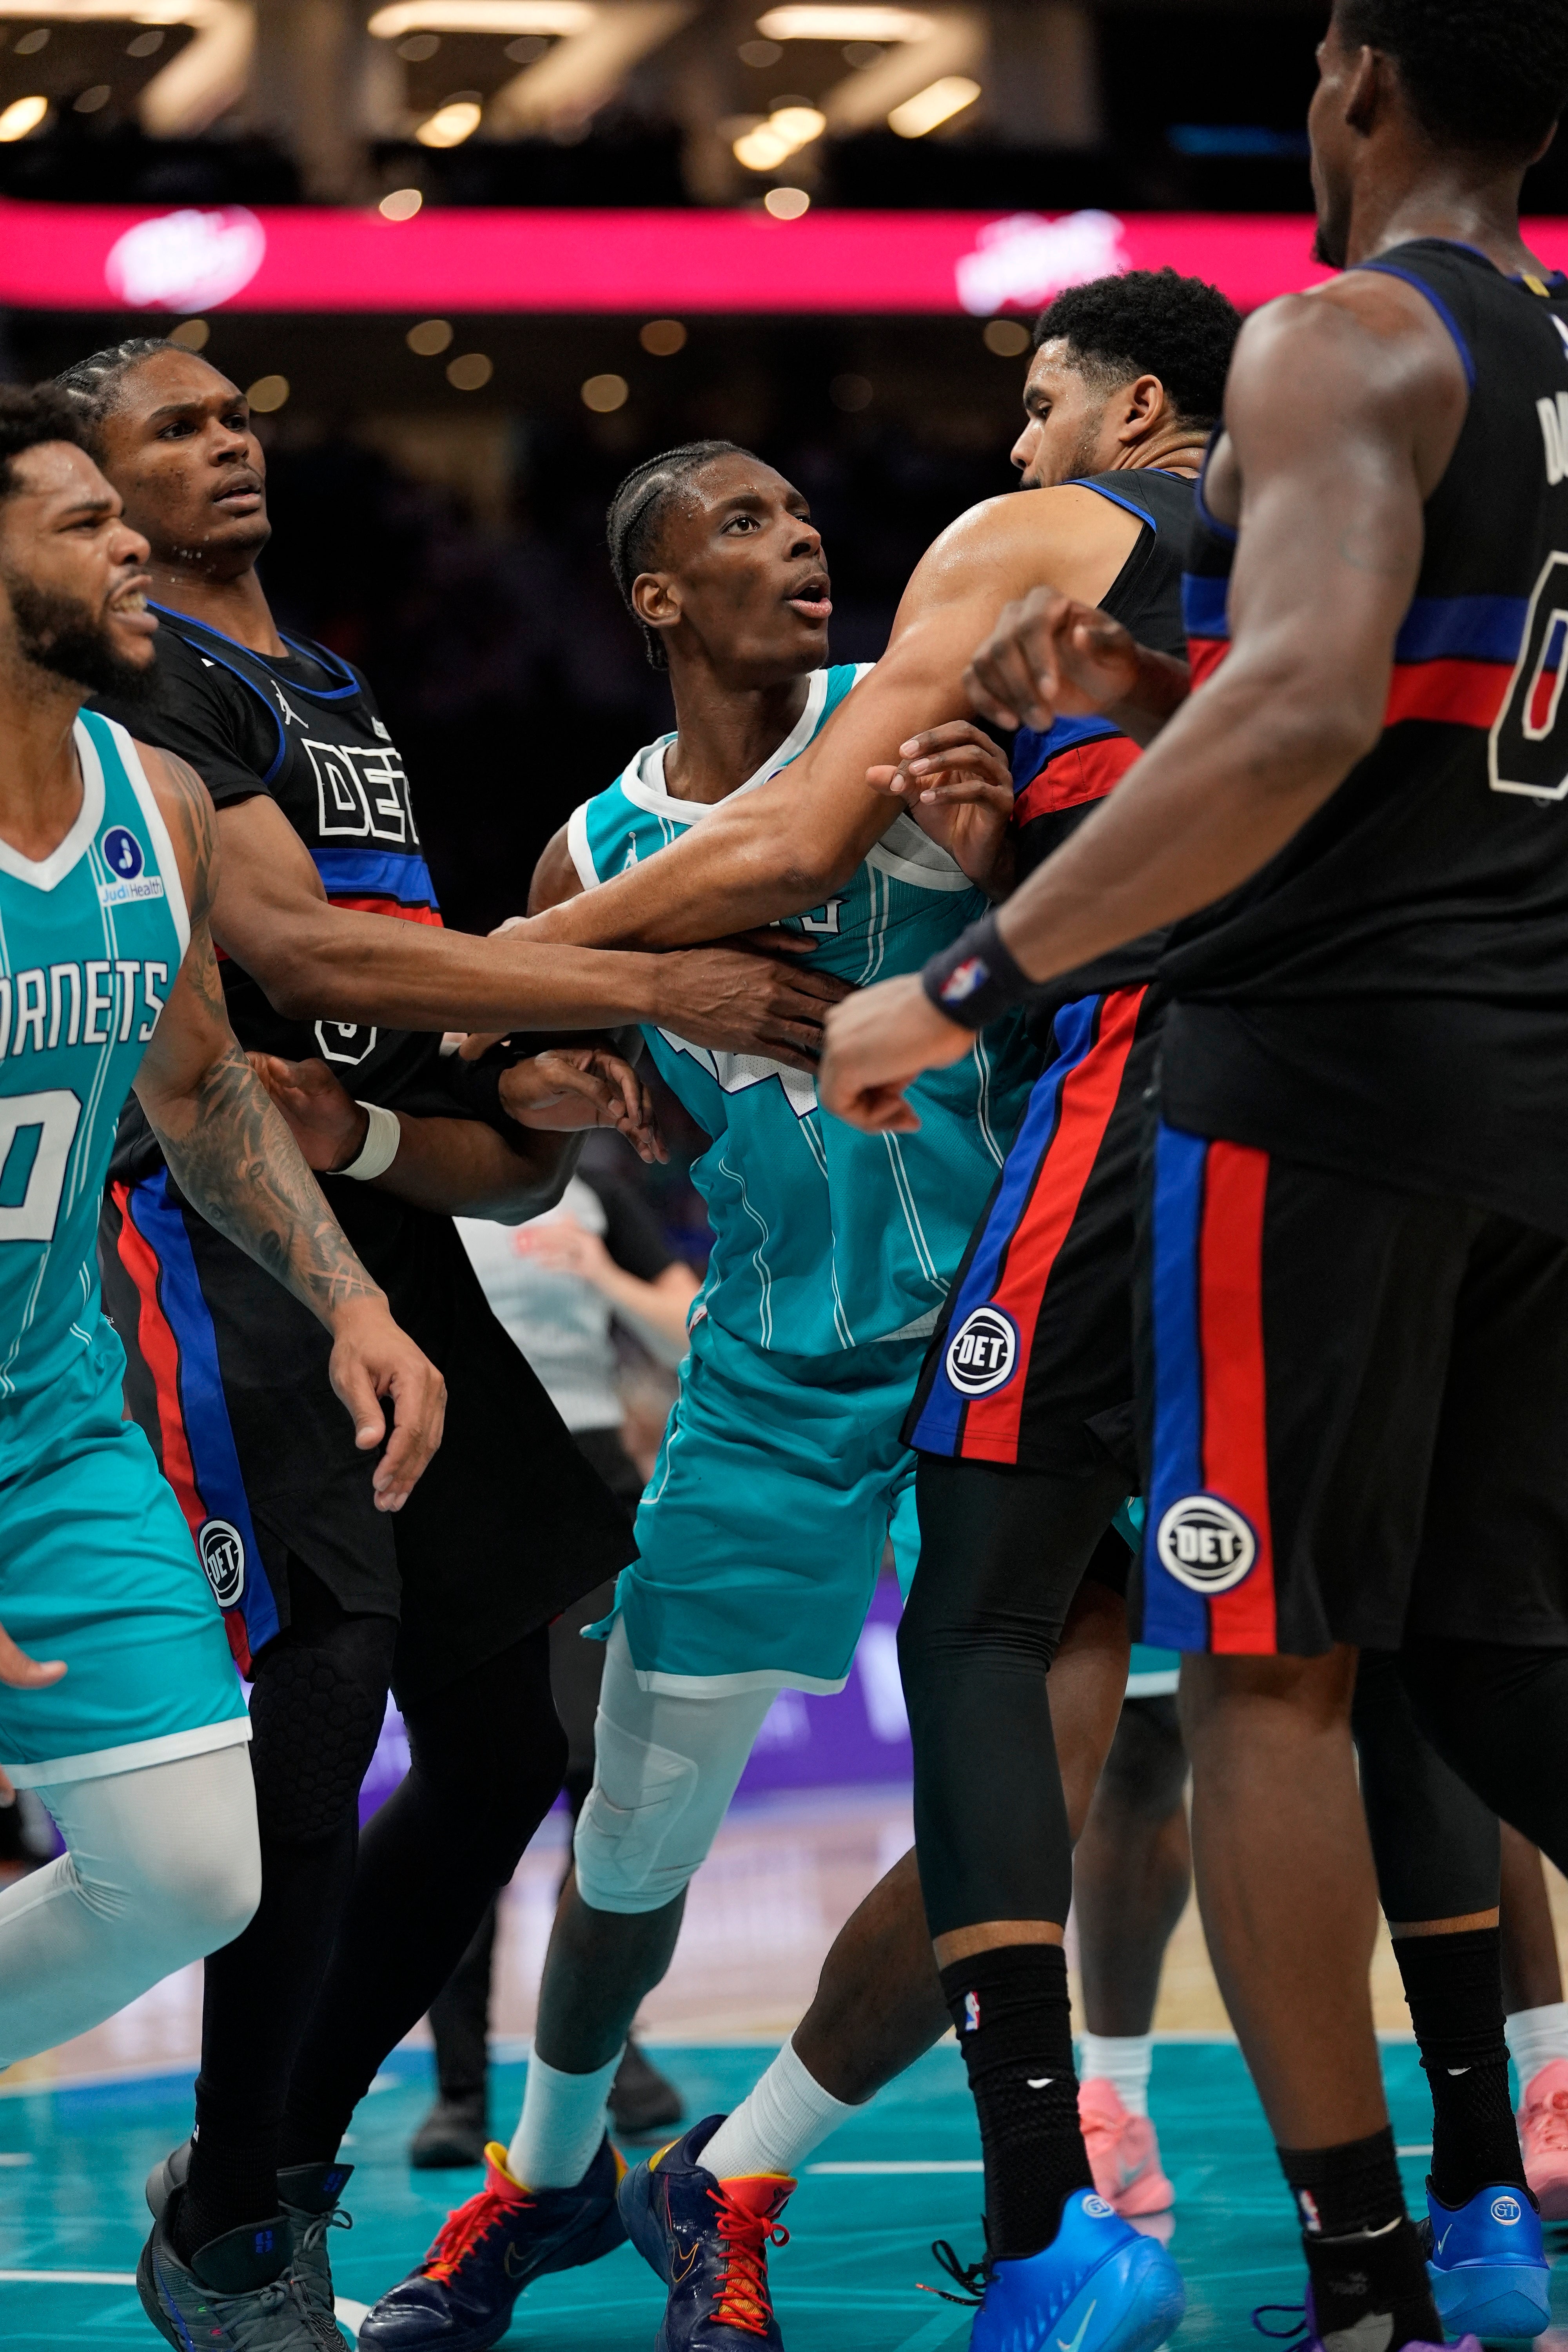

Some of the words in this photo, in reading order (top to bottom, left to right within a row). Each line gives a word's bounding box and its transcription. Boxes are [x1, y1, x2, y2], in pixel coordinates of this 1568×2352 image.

[957, 1334, 1005, 1368] DET
[1175, 1525, 1235, 1563] DET
[207, 1540, 235, 1585] DET
[1494, 2203, 1517, 2217] GT
